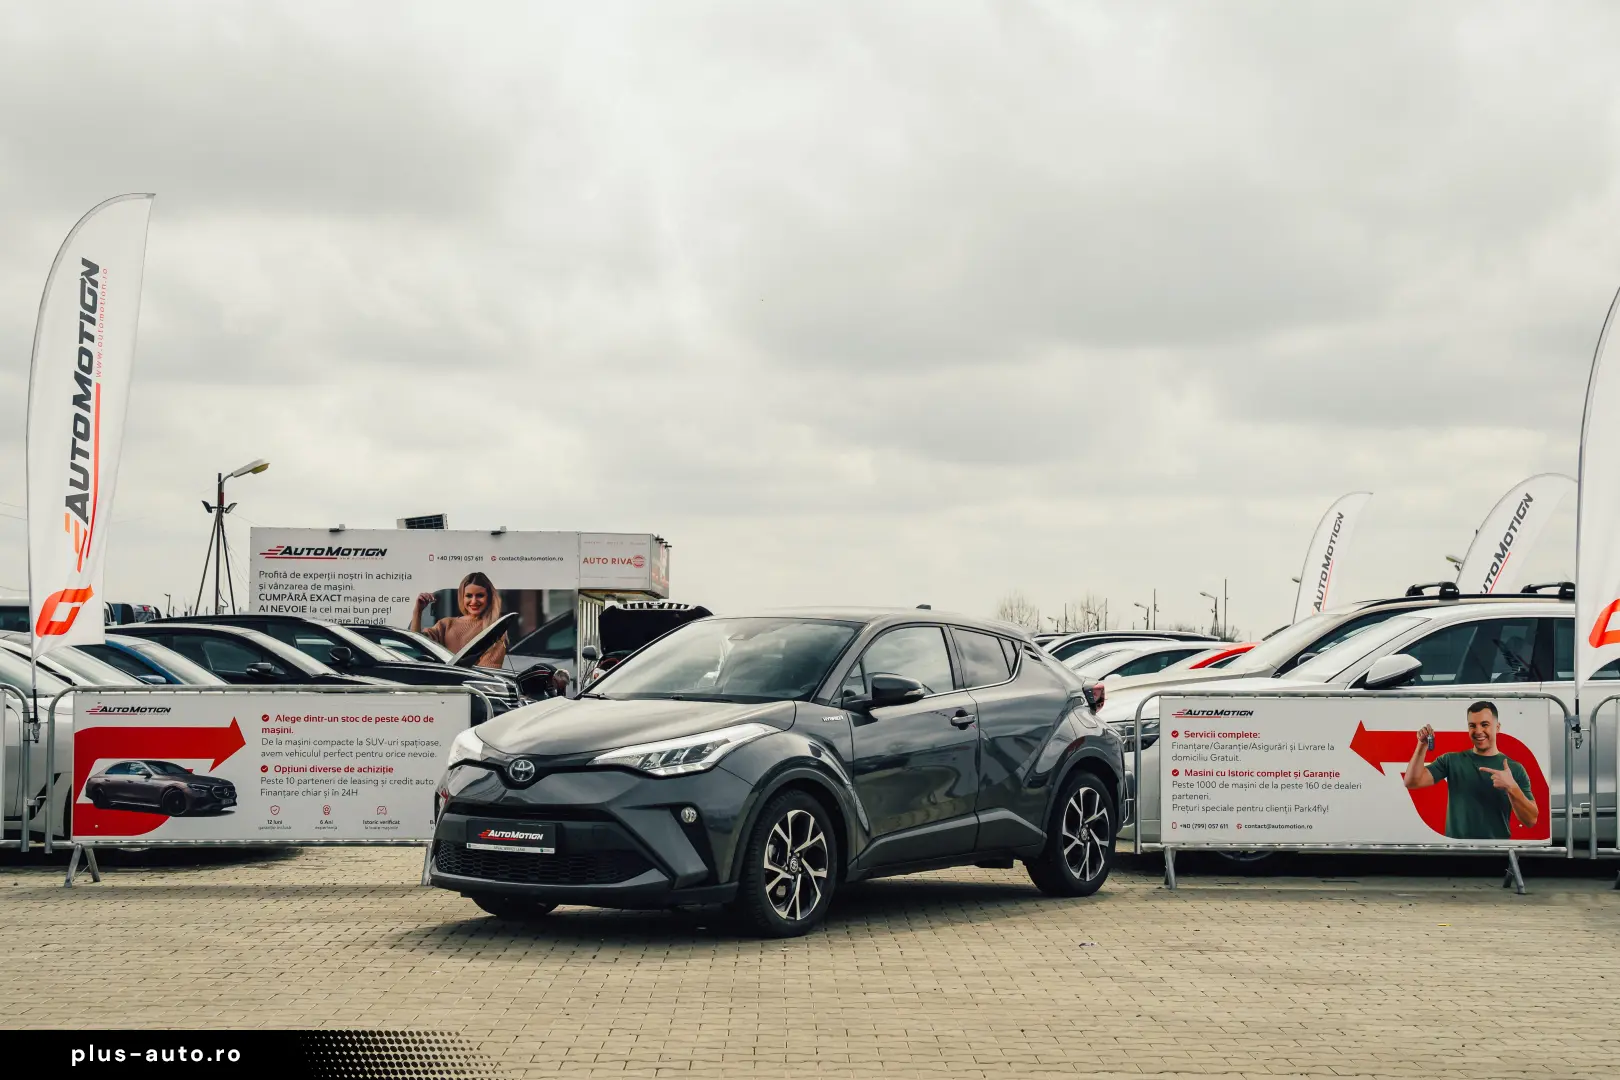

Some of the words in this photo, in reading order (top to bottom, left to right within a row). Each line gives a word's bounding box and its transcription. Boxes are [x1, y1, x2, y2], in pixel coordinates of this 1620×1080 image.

[338, 572, 362, 580] noștri
[376, 572, 412, 581] achiziția
[258, 583, 266, 591] și
[324, 583, 355, 592] mașini.
[259, 592, 308, 601] CUMPĂRĂ
[344, 595, 375, 603] mașina
[372, 606, 391, 615] preț!
[275, 714, 301, 724] Alege
[375, 716, 399, 724] peste
[262, 726, 293, 735] mașini.
[1218, 731, 1260, 740] complete:
[285, 738, 310, 748] mașini
[312, 739, 354, 748] compacte
[357, 738, 363, 746] la
[366, 738, 398, 746] SUV-uri
[1290, 743, 1295, 752] și
[323, 749, 353, 758] perfect
[356, 751, 383, 759] pentru
[274, 765, 307, 774] Opțiuni
[357, 766, 394, 774] achiziție
[1256, 770, 1291, 779] complet
[1294, 770, 1300, 779] și
[1303, 770, 1340, 779] Garanție
[297, 778, 335, 786] parteneri
[350, 777, 378, 787] leasing
[381, 778, 387, 787] și
[389, 777, 413, 785] credit
[1232, 782, 1256, 791] mașini
[1281, 782, 1303, 791] peste
[261, 788, 299, 798] Finanțare
[324, 789, 329, 798] și
[1172, 793, 1211, 802] parteneri.
[1172, 804, 1199, 814] Prețuri
[1202, 804, 1234, 814] speciale
[1236, 805, 1263, 814] pentru
[1266, 805, 1292, 814] clienții
[1294, 804, 1329, 814] Park4fly!
